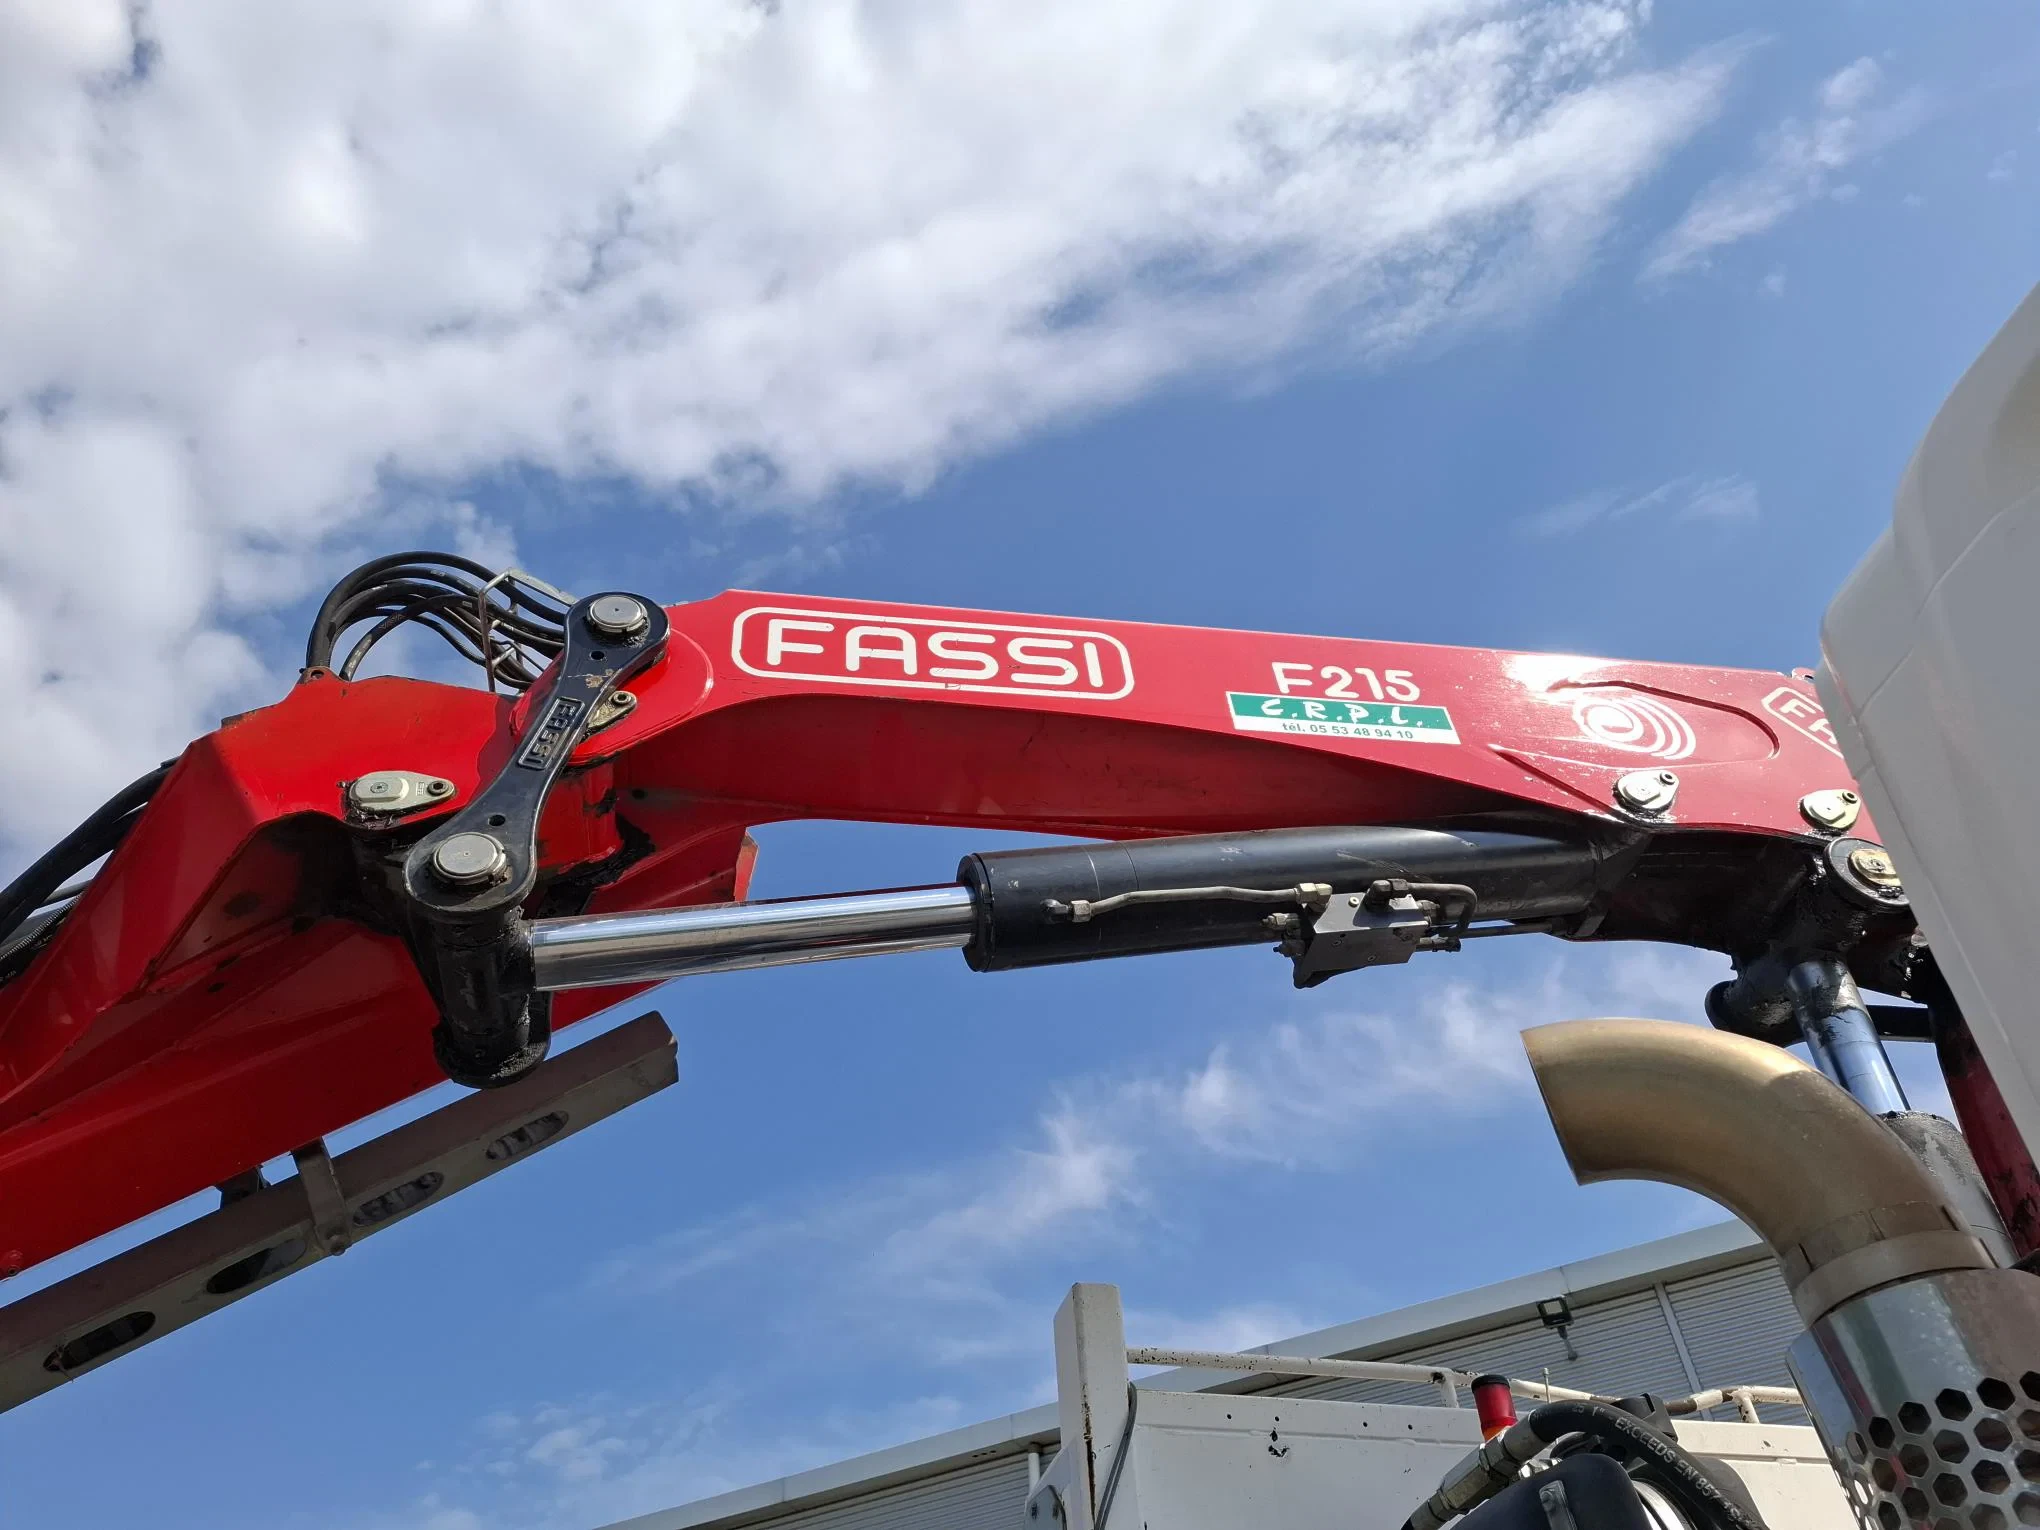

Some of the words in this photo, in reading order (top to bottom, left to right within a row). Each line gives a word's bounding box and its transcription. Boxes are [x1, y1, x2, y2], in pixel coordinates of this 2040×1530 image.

[767, 618, 1104, 688] FASSI
[1309, 724, 1328, 734] 05
[1331, 725, 1349, 735] 53
[1353, 727, 1371, 737] 48
[1374, 728, 1393, 738] 94
[1396, 730, 1414, 739] 10
[1780, 698, 1838, 745] FA
[1615, 1415, 1676, 1464] EXCEEDS
